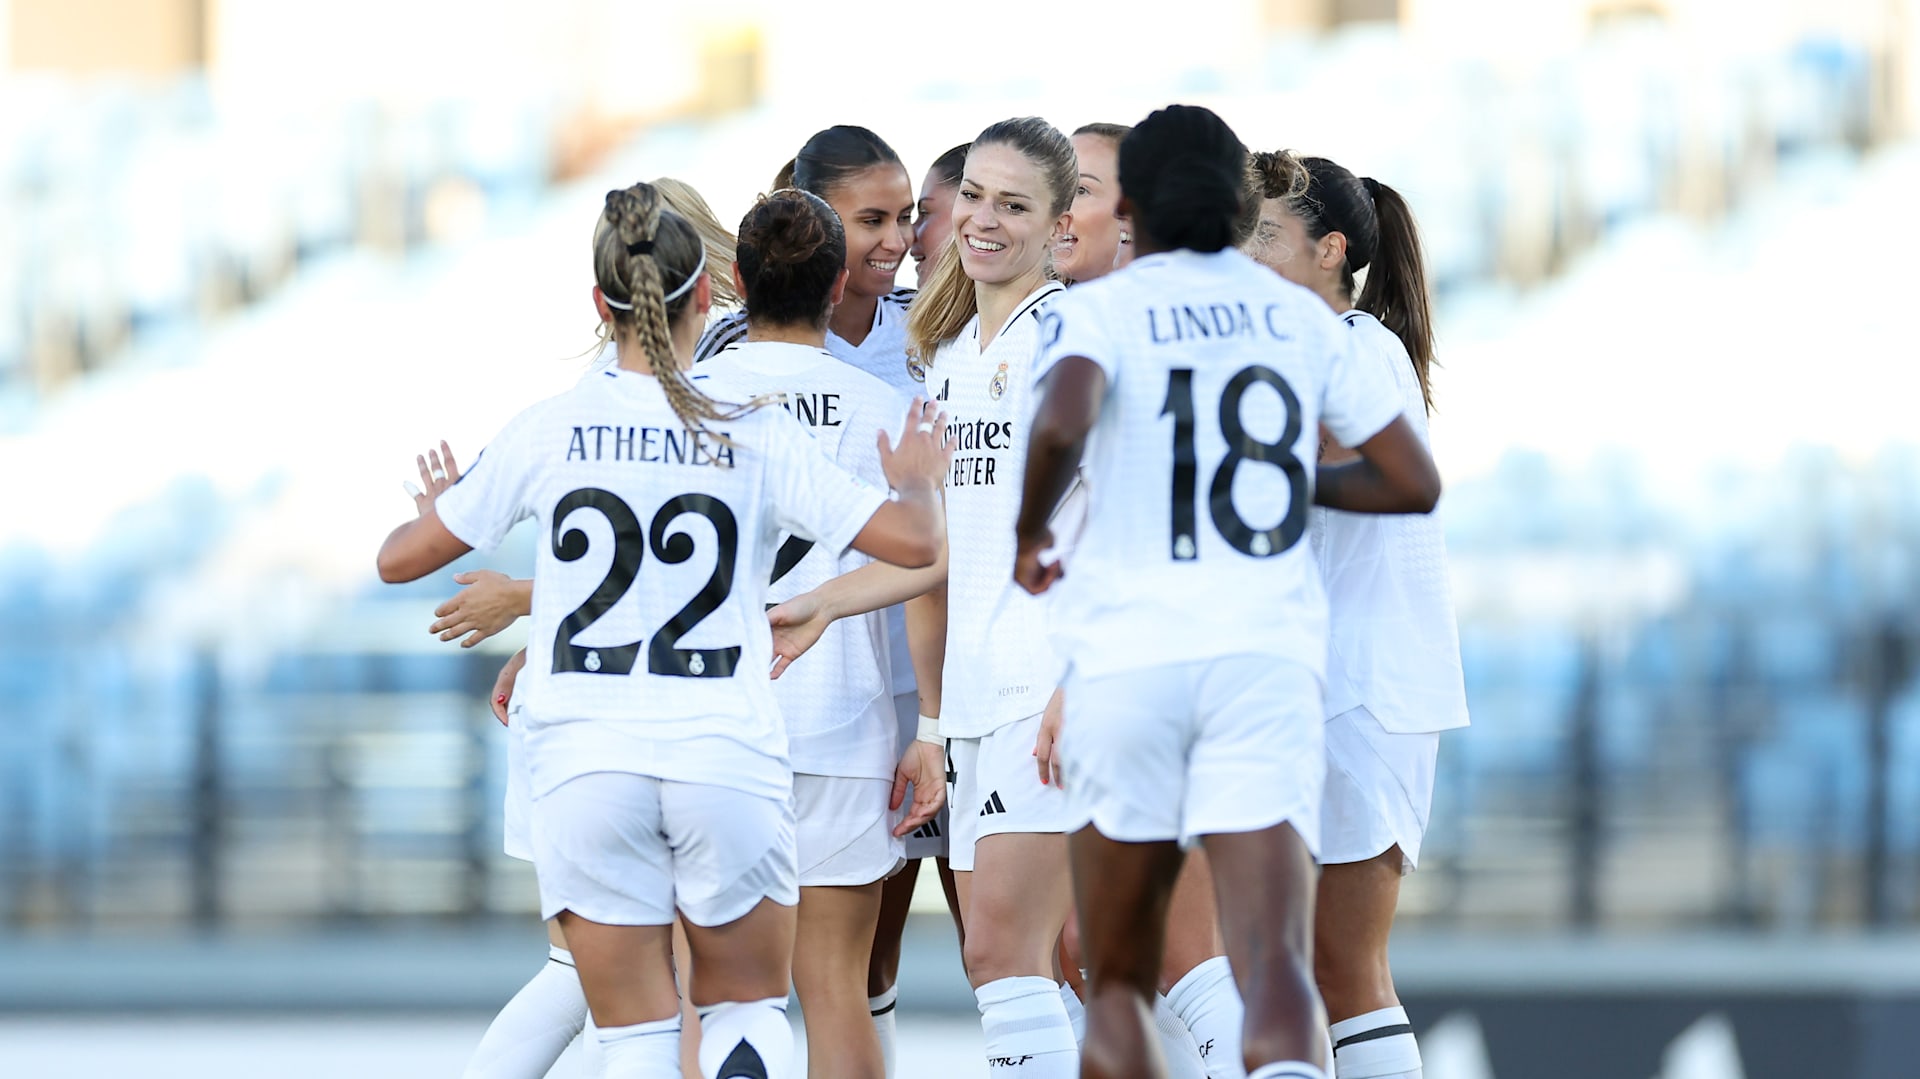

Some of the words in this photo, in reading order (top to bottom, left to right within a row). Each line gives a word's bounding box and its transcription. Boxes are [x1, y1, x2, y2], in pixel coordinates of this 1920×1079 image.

[1147, 301, 1257, 345] LINDA
[566, 425, 735, 469] ATHENEA
[937, 414, 1012, 451] irates
[1158, 364, 1310, 560] 18
[551, 487, 742, 678] 22
